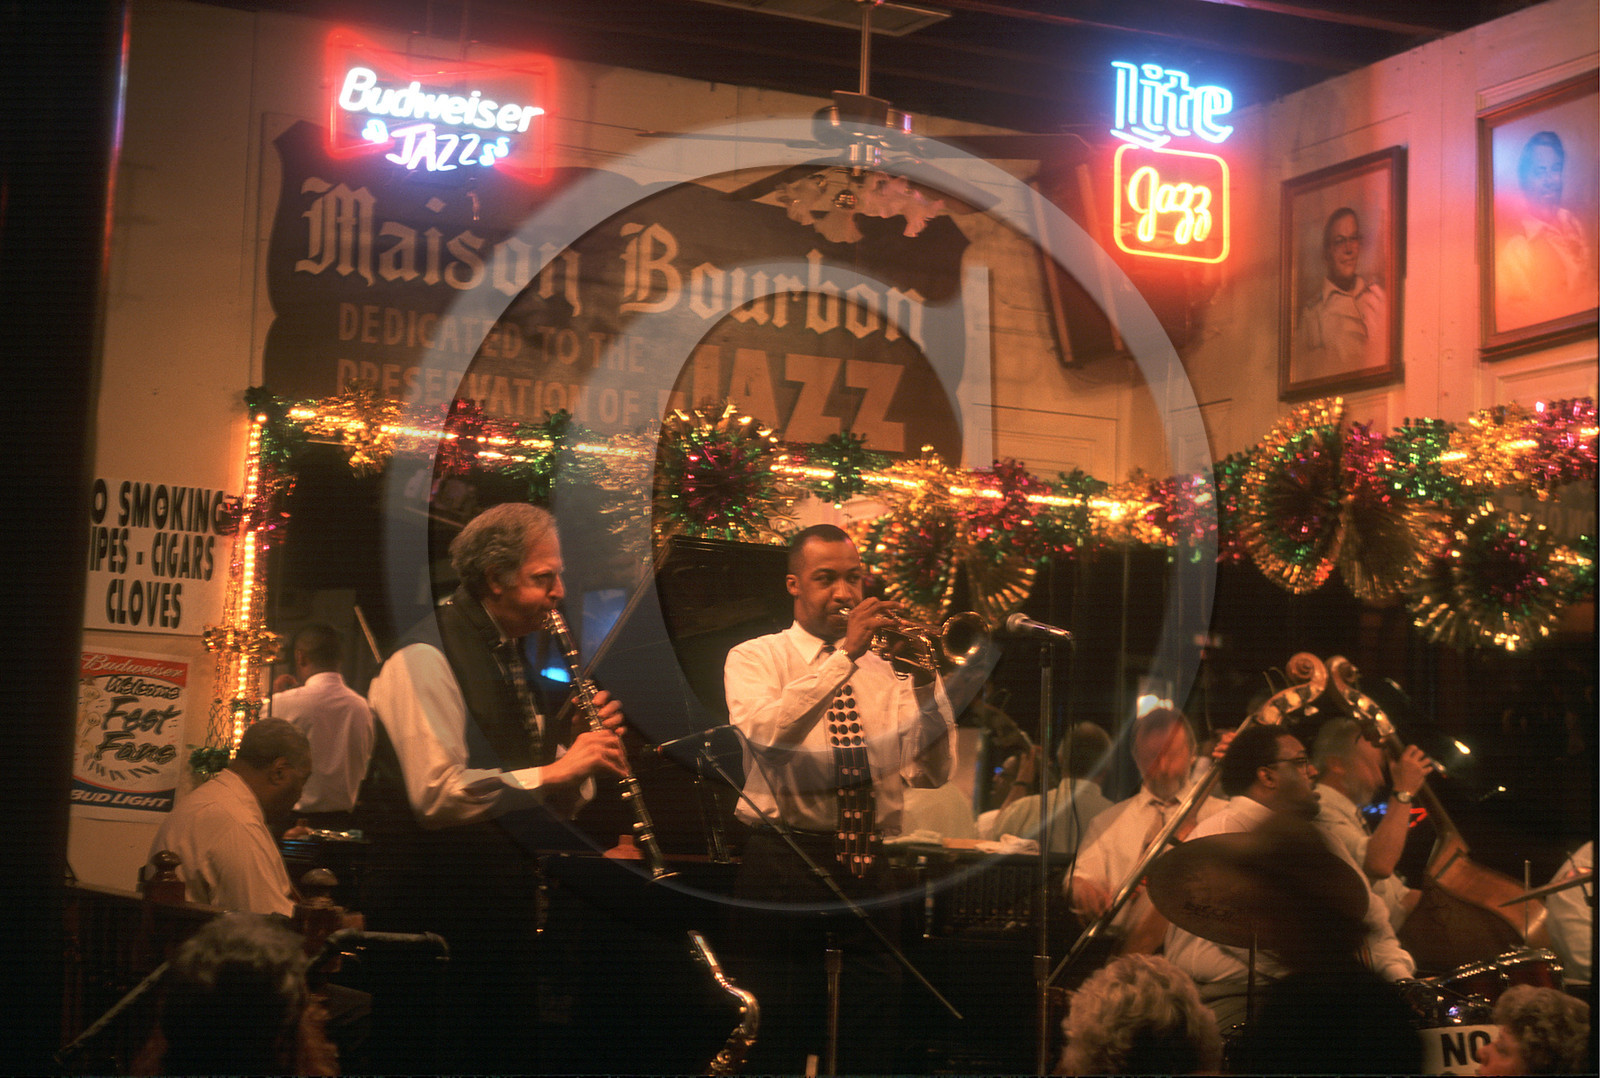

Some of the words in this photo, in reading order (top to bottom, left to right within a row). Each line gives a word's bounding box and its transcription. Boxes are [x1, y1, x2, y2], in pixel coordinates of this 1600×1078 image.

[338, 66, 545, 133] Budweiser
[1110, 60, 1234, 149] Lite
[385, 123, 481, 172] JAZZ
[1127, 166, 1213, 245] Jazz
[295, 176, 582, 317] Maison
[619, 222, 927, 353] Bourbon
[338, 302, 522, 360] DEDICATED
[536, 325, 580, 366] TO
[589, 332, 645, 373] THE
[336, 358, 590, 423] PRESERVATION
[601, 388, 640, 426] OF
[656, 344, 905, 452] JAZZ
[118, 480, 226, 535] SMOKING
[152, 532, 215, 581] CIGARS
[106, 578, 182, 629] CLOVES
[82, 652, 184, 678] Budweiser
[105, 676, 181, 700] Welcome
[101, 695, 182, 735] Fest
[94, 731, 177, 765] Fans
[71, 789, 111, 802] BUD
[111, 793, 171, 808] LIGHT
